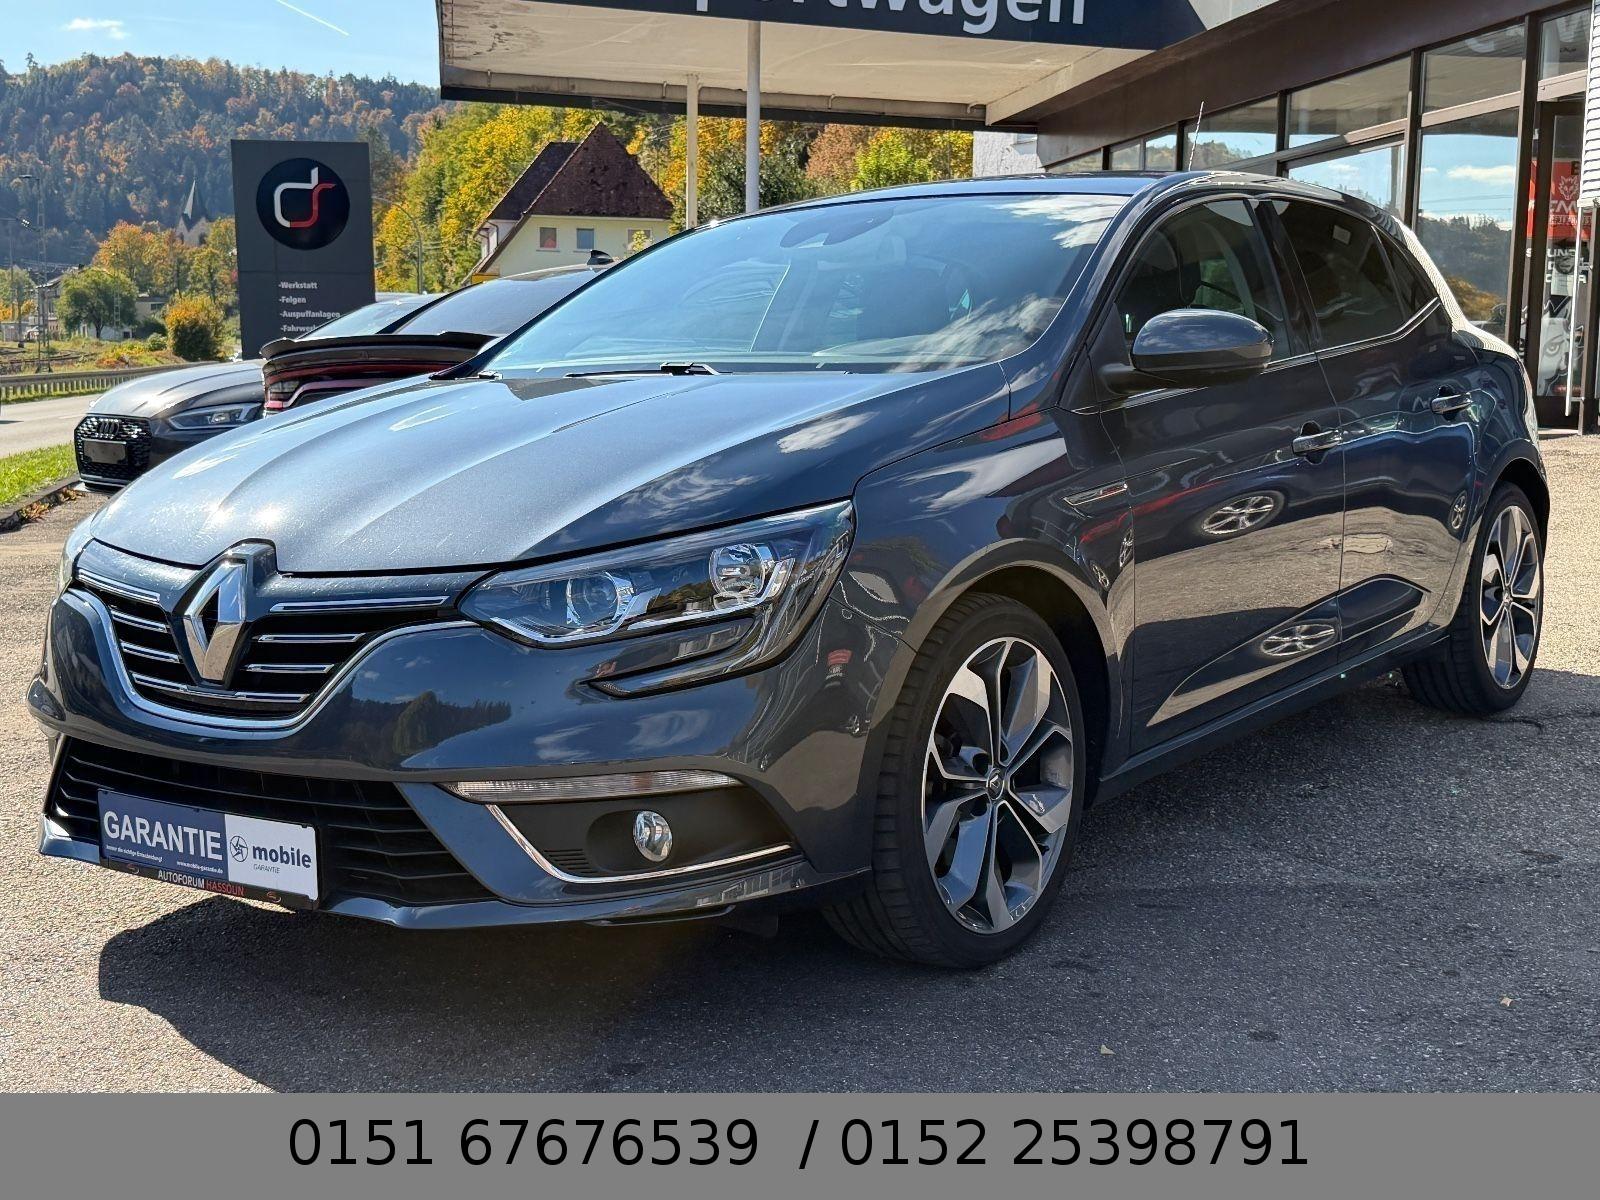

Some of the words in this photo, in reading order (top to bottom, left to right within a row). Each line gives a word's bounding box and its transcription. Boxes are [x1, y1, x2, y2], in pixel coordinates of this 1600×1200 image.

[103, 811, 223, 860] GARANTIE
[252, 844, 312, 868] mobile
[253, 863, 281, 874] GARANTIE
[158, 869, 205, 889] AUTOFORUM
[205, 879, 245, 896] HASSOUN
